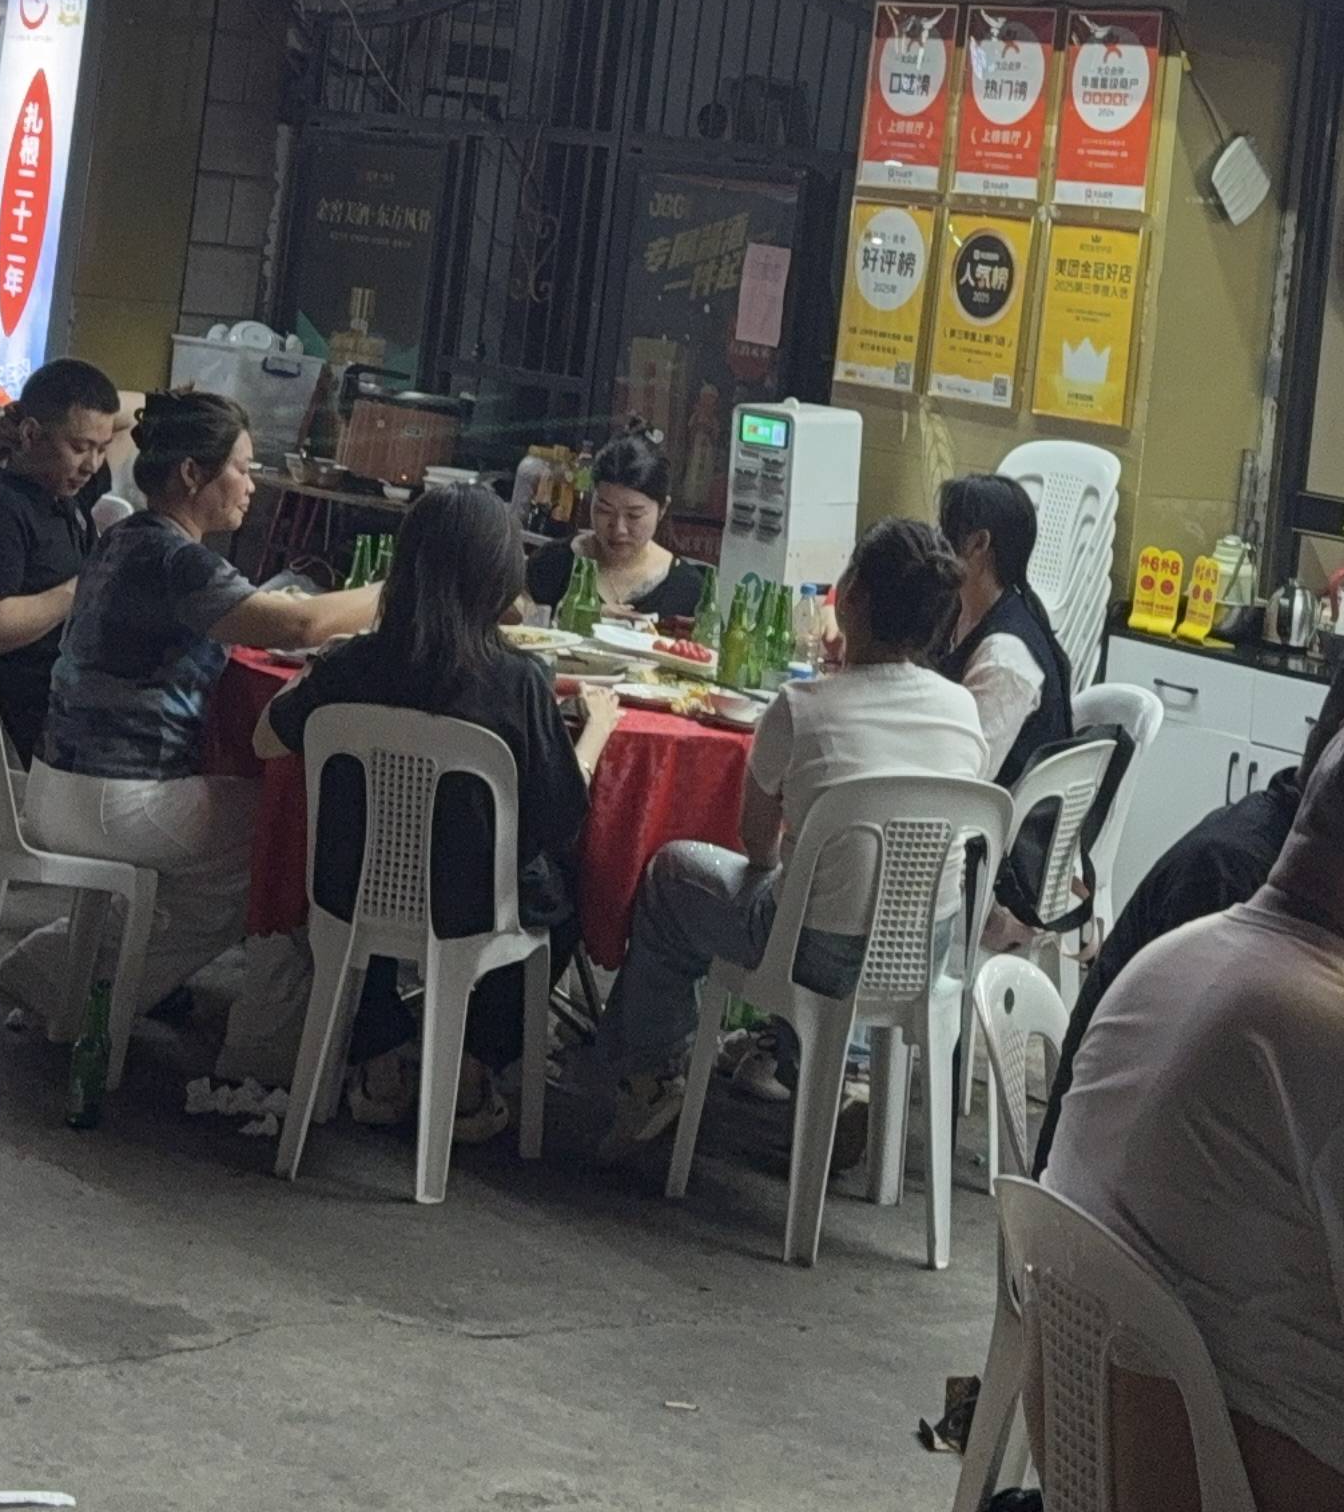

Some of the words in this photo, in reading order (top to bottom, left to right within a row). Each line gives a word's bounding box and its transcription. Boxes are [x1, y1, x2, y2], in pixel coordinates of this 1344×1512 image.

[983, 79, 1028, 101] 热门榜
[3, 102, 44, 297] 扎根二十二年
[861, 246, 917, 278] 好评榜
[959, 262, 1009, 291] 人气榜
[1055, 257, 1133, 284] 美团金冠好店
